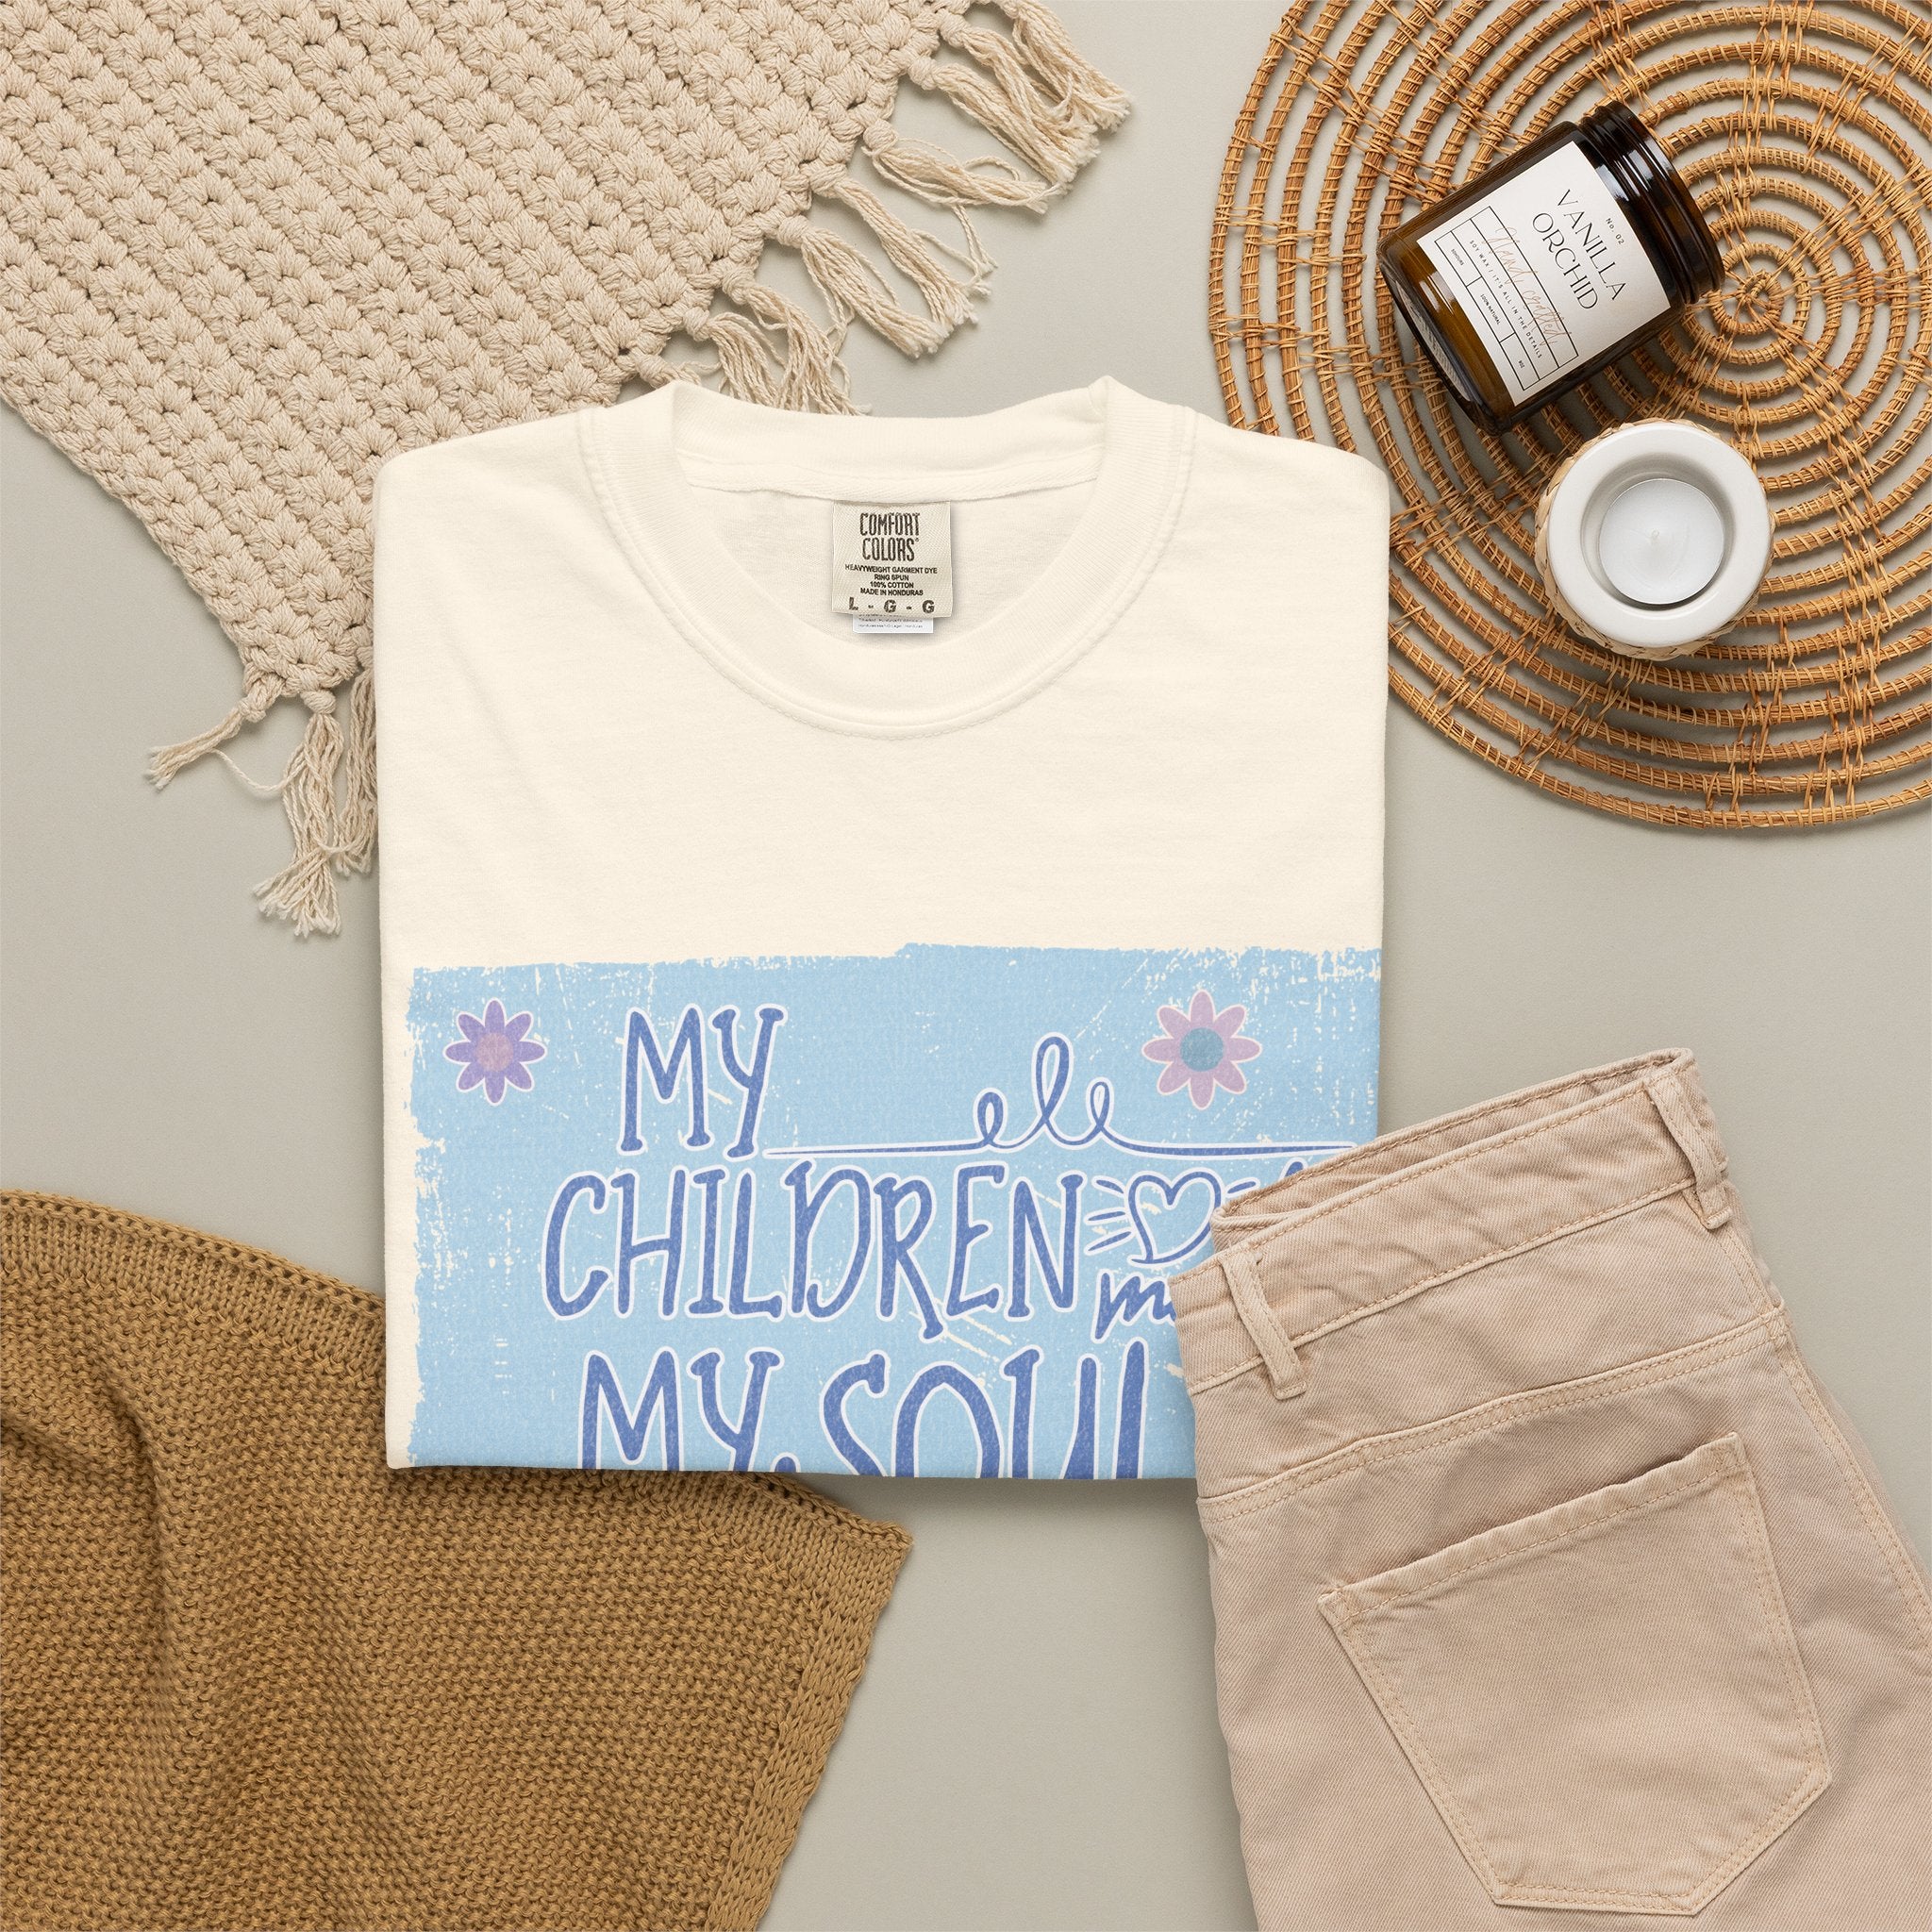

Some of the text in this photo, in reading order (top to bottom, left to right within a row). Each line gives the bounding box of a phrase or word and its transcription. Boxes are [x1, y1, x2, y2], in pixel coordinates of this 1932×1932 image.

[1532, 212, 1598, 309] ORCHID
[1557, 189, 1626, 301] VANILLA
[1615, 234, 1624, 245] 02
[1470, 240, 1479, 252] SOY
[1479, 253, 1490, 267] WAX
[1492, 275, 1504, 289] IT'S
[1503, 291, 1511, 305] ALL
[1511, 306, 1519, 315] IN
[1518, 316, 1528, 330] THE
[1525, 331, 1542, 358] DETAILS
[1480, 293, 1501, 325] 100% NATURAL
[844, 564, 891, 574] HEAVYWEIGHT
[891, 566, 924, 575] GARMENT
[859, 512, 921, 536] COMFORT
[848, 596, 859, 611] L
[883, 599, 897, 613] G
[922, 599, 935, 614] G
[617, 1006, 787, 1158] MY
[542, 1158, 1083, 1340] CHILDREN
[579, 1349, 782, 1473] MY
